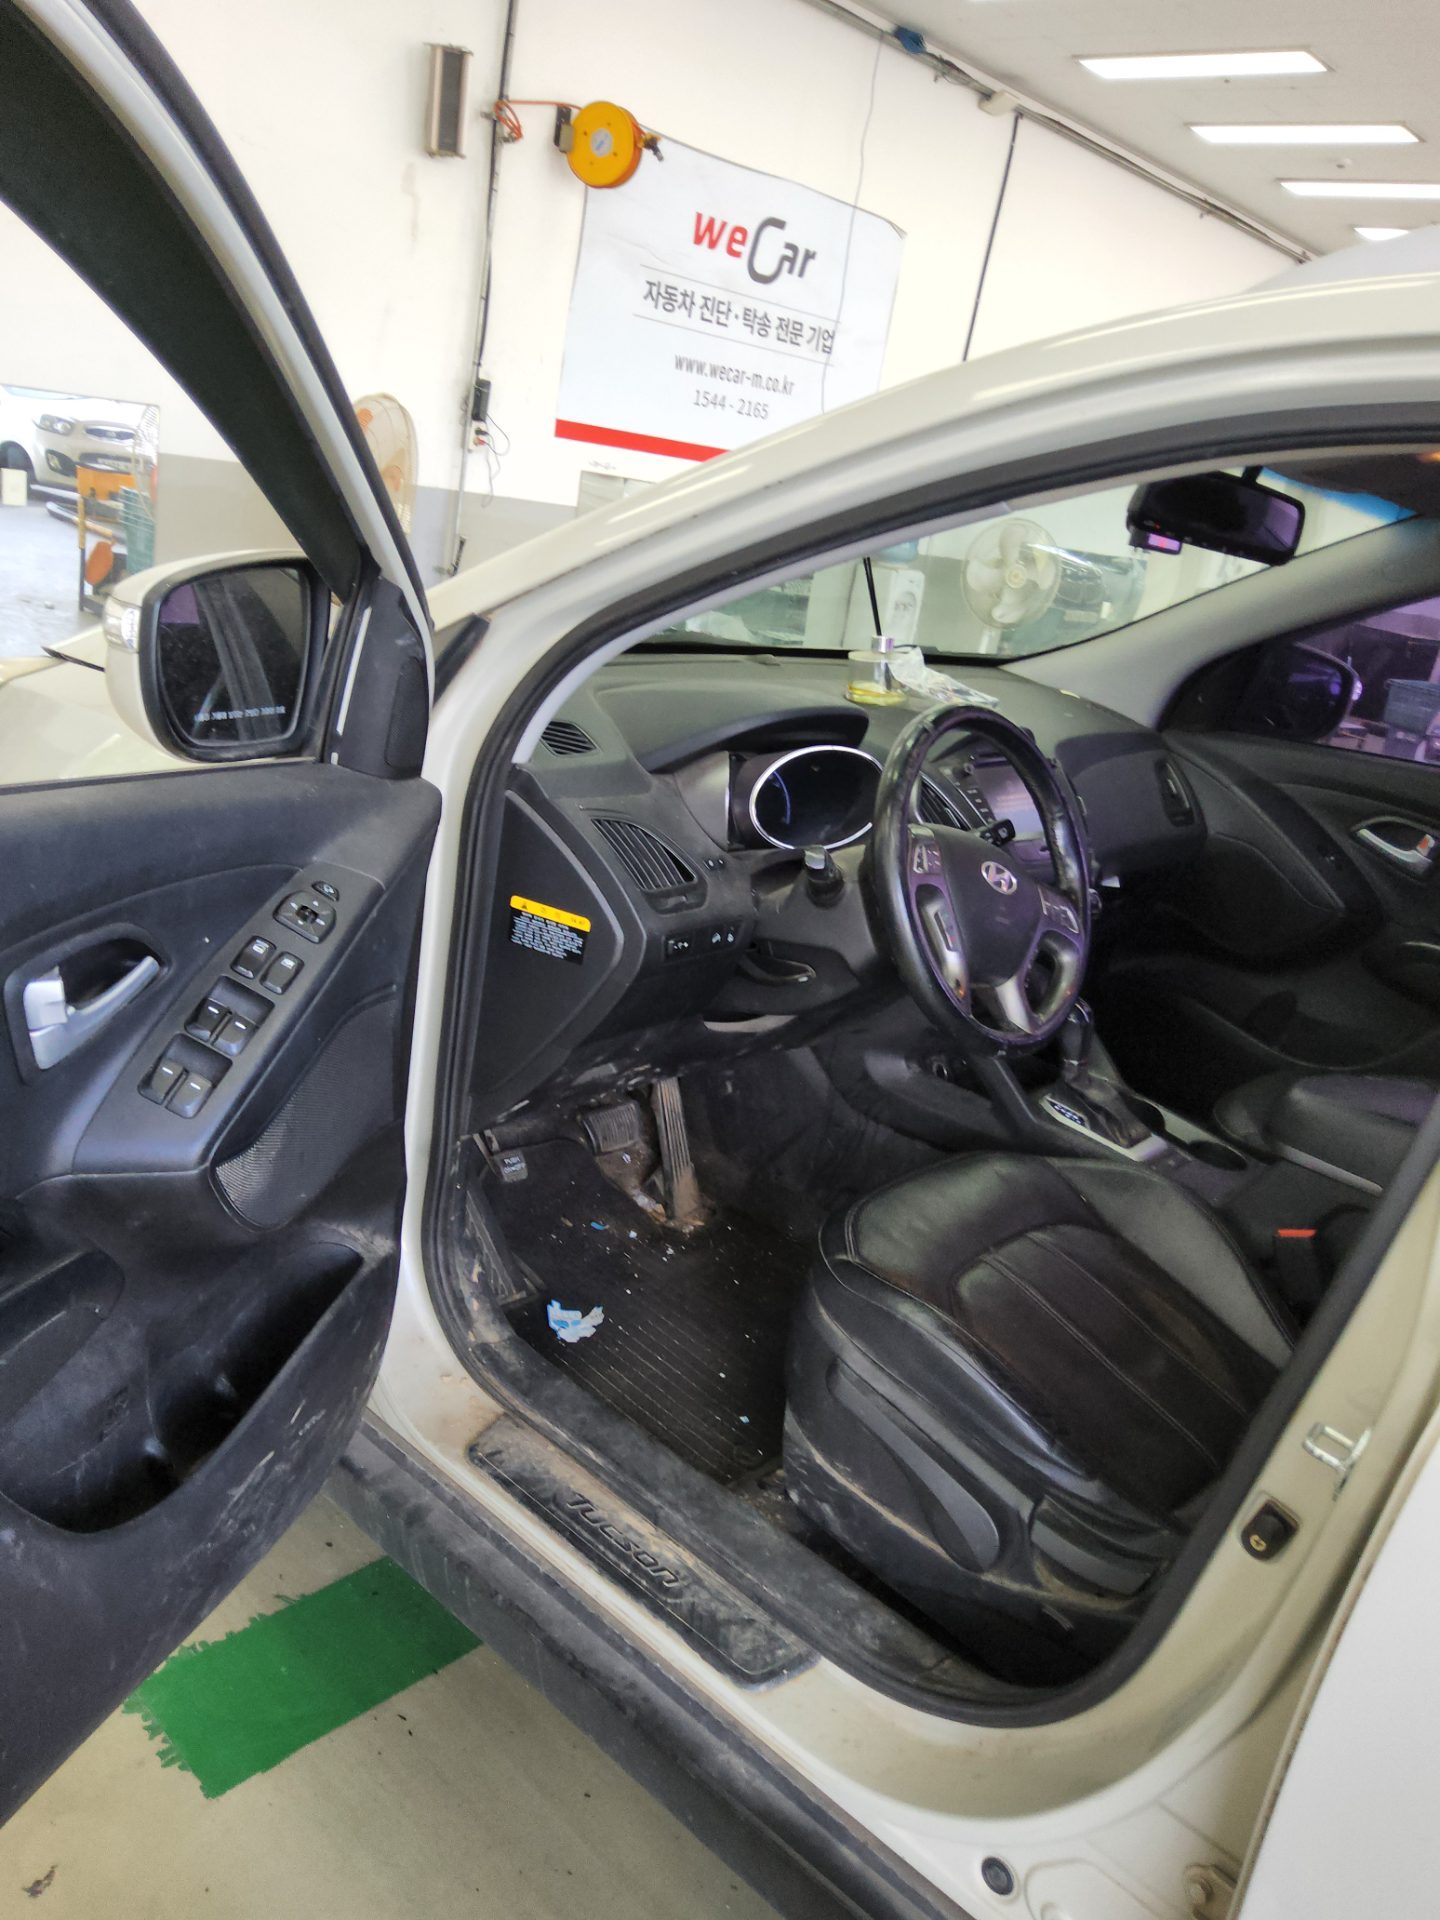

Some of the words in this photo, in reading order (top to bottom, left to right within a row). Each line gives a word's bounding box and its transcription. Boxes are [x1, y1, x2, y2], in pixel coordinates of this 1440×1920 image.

[643, 279, 695, 319] 자동차
[776, 316, 804, 346] 전문
[806, 326, 836, 354] 기업
[675, 355, 795, 395] www.wecar-m.co.kr
